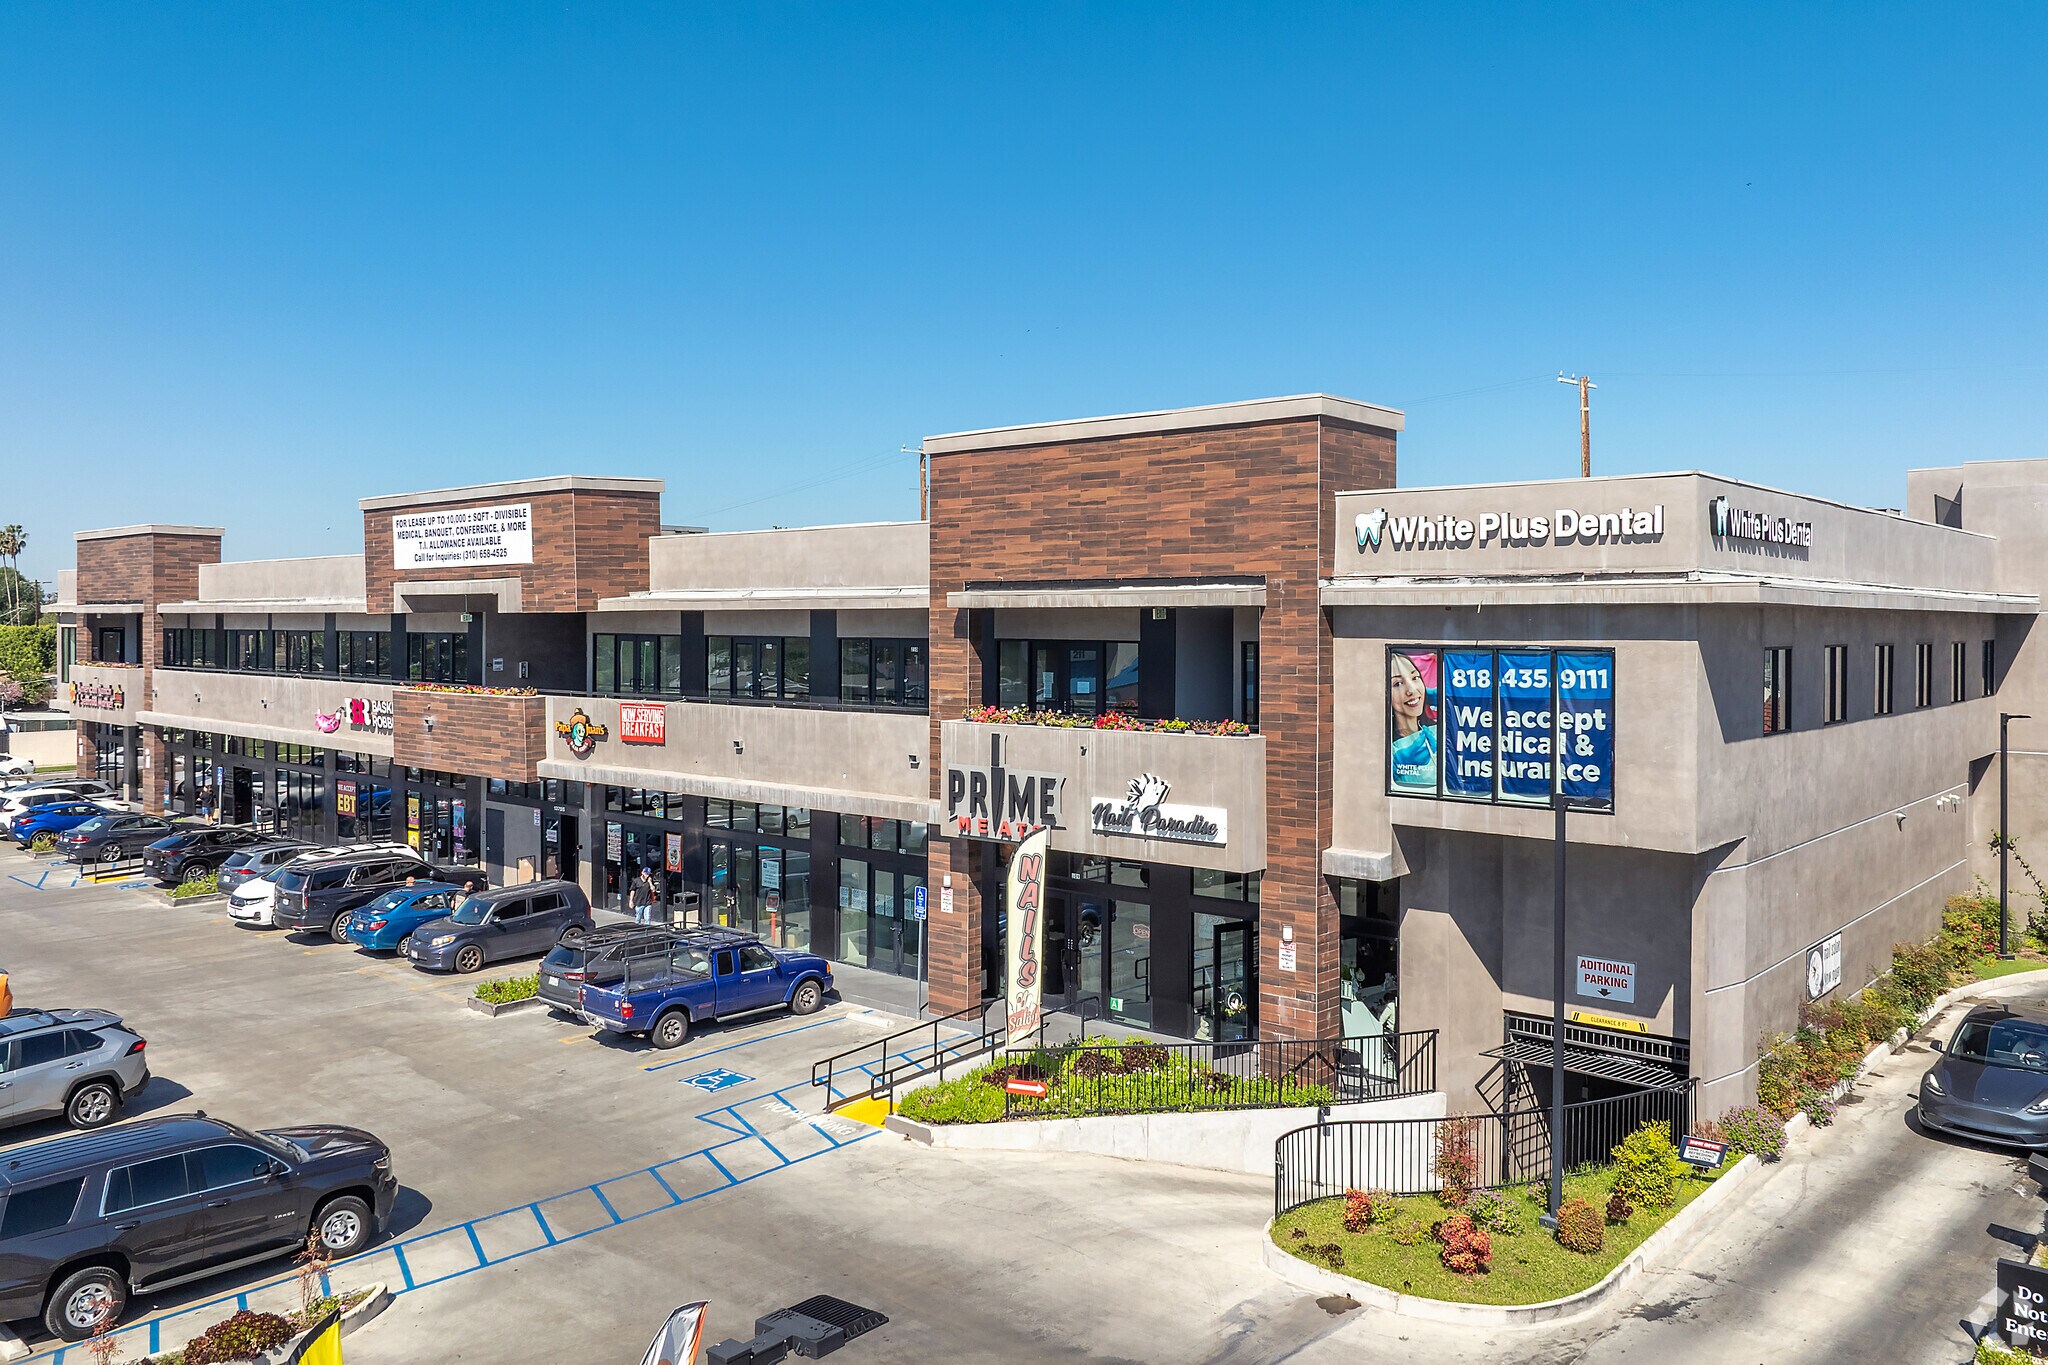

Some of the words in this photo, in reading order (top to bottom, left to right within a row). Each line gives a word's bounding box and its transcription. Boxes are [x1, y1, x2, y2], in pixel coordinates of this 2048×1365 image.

[396, 519, 408, 528] FOR
[408, 517, 426, 527] LEASE
[427, 516, 436, 525] UP
[437, 516, 445, 525] TO
[446, 513, 467, 524] 10,000
[473, 511, 489, 522] SQFT
[494, 508, 527, 520] DIVISIBLE
[1389, 515, 1474, 543] White
[1479, 511, 1550, 540] Plus
[1555, 505, 1665, 538] Dental
[1730, 508, 1761, 539] White
[1762, 513, 1785, 543] Plus
[1785, 518, 1813, 547] Dental
[397, 529, 423, 540] MEDICAL,
[424, 527, 455, 538] BANQUET,
[456, 523, 500, 536] CONFERENCE,
[500, 523, 506, 532] &
[507, 521, 527, 532] MORE
[429, 538, 465, 549] ALLOWANCE
[466, 535, 501, 547] AVAILABLE
[414, 553, 426, 562] Call
[426, 552, 434, 561] for
[435, 551, 462, 562] Inquiries:
[462, 549, 479, 561] (310)
[479, 548, 508, 559] 658-4525
[372, 700, 393, 714] BASKI
[622, 708, 636, 723] NOW
[637, 708, 664, 724] SERVING
[372, 714, 393, 729] ROBB
[555, 721, 571, 735] Papa
[585, 724, 604, 736] Juan's
[1454, 705, 1492, 728] We
[1505, 708, 1606, 734] accept
[622, 722, 664, 739] BREAKFAST
[1457, 730, 1566, 754] Medical
[1575, 734, 1594, 756] &
[1457, 755, 1600, 782] Insurance
[337, 783, 343, 791] WE
[337, 793, 356, 813] EBT
[949, 767, 1057, 830] PRIME
[1092, 802, 1134, 829] Nails
[1139, 806, 1218, 836] Paradise
[1017, 853, 1043, 989] NAILS
[1580, 959, 1633, 976] ADITIONAL
[1584, 973, 1628, 989] PARKING
[1590, 1016, 1617, 1026] CLEARANCE
[760, 1101, 786, 1113] NO
[2018, 1285, 2044, 1304] Do
[2014, 1302, 2048, 1323] Not
[2006, 1317, 2048, 1341] Ente
